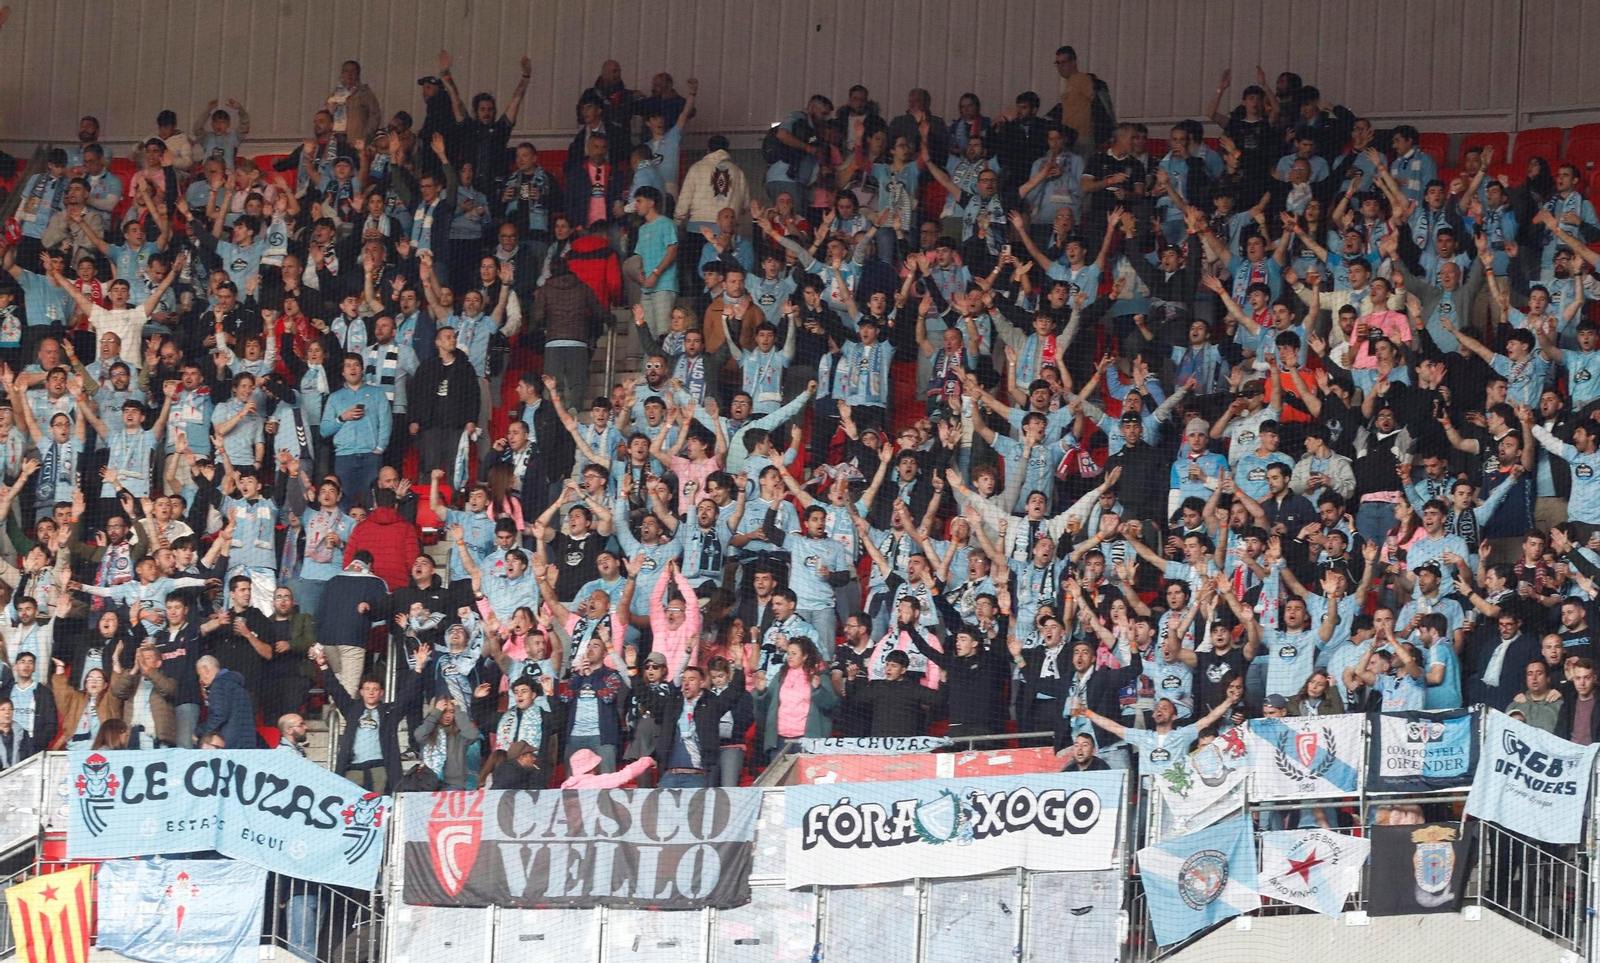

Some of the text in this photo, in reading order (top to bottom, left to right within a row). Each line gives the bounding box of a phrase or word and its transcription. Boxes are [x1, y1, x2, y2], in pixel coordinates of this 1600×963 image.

[1387, 745, 1465, 758] COMPOSTELA
[121, 758, 344, 829] LE CHUZAS
[497, 788, 731, 843] CASCO
[802, 786, 1101, 850] FÓRA XOGO
[498, 842, 722, 900] VELLO
